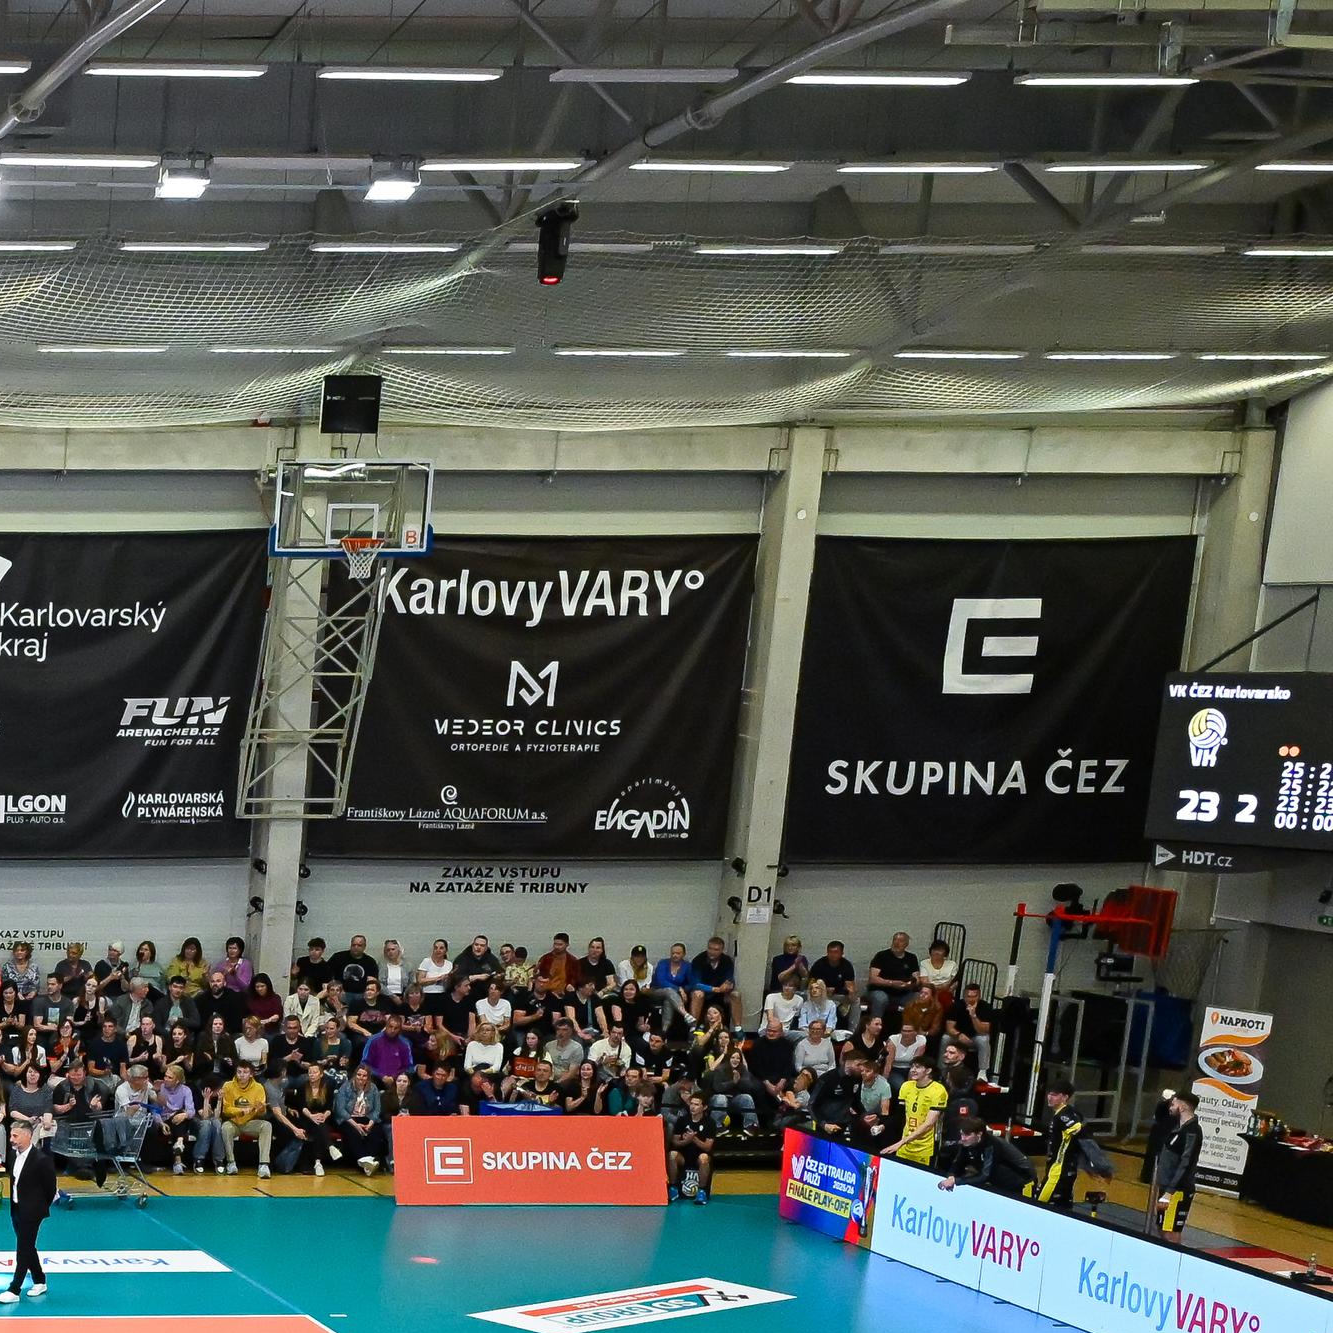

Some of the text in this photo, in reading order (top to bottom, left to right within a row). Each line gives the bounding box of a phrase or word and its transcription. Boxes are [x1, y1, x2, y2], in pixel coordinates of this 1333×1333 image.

[0, 601, 167, 633] Karlovarský
[1169, 682, 1291, 700] VK ČEZ Karlovarsko
[119, 696, 232, 726] FUN
[116, 727, 221, 738] ARENACHEB.CZ
[434, 718, 621, 736] MEDEOR CLINICS
[144, 739, 169, 747] FUN
[195, 738, 217, 746] ALL
[450, 743, 601, 753] ORTOPEDIE A FYZIOTERAPIE
[825, 748, 1130, 796] SKUPINA ČEZ
[1281, 761, 1305, 779] 25
[1278, 778, 1303, 795] 25
[137, 790, 225, 804] KARLOVARSKÁ
[1276, 795, 1301, 812] 23
[137, 803, 224, 819] PLYNÁRENSKÁ
[346, 805, 548, 821] Františkovy Lázně AQUAFORUM a.s.
[1176, 789, 1258, 823] 23 2
[6, 816, 51, 824] PLUS AUTO
[1274, 812, 1333, 832] 00 00
[498, 867, 561, 879] VSTUPU
[409, 879, 590, 894] NA ZATAŽENÉ TRIBUNY
[746, 886, 773, 903] D1
[23, 929, 64, 938] VSTUPU
[1219, 1015, 1266, 1031] NAPROTI
[481, 1147, 633, 1172] SKUPINA ČEZ
[803, 1170, 821, 1187] MUŽI
[805, 1155, 857, 1185] ČEZ EXTRALIGA
[813, 1190, 850, 1213] PLAY-OFF
[651, 1296, 699, 1314] SD
[564, 1303, 654, 1325] GROUP
